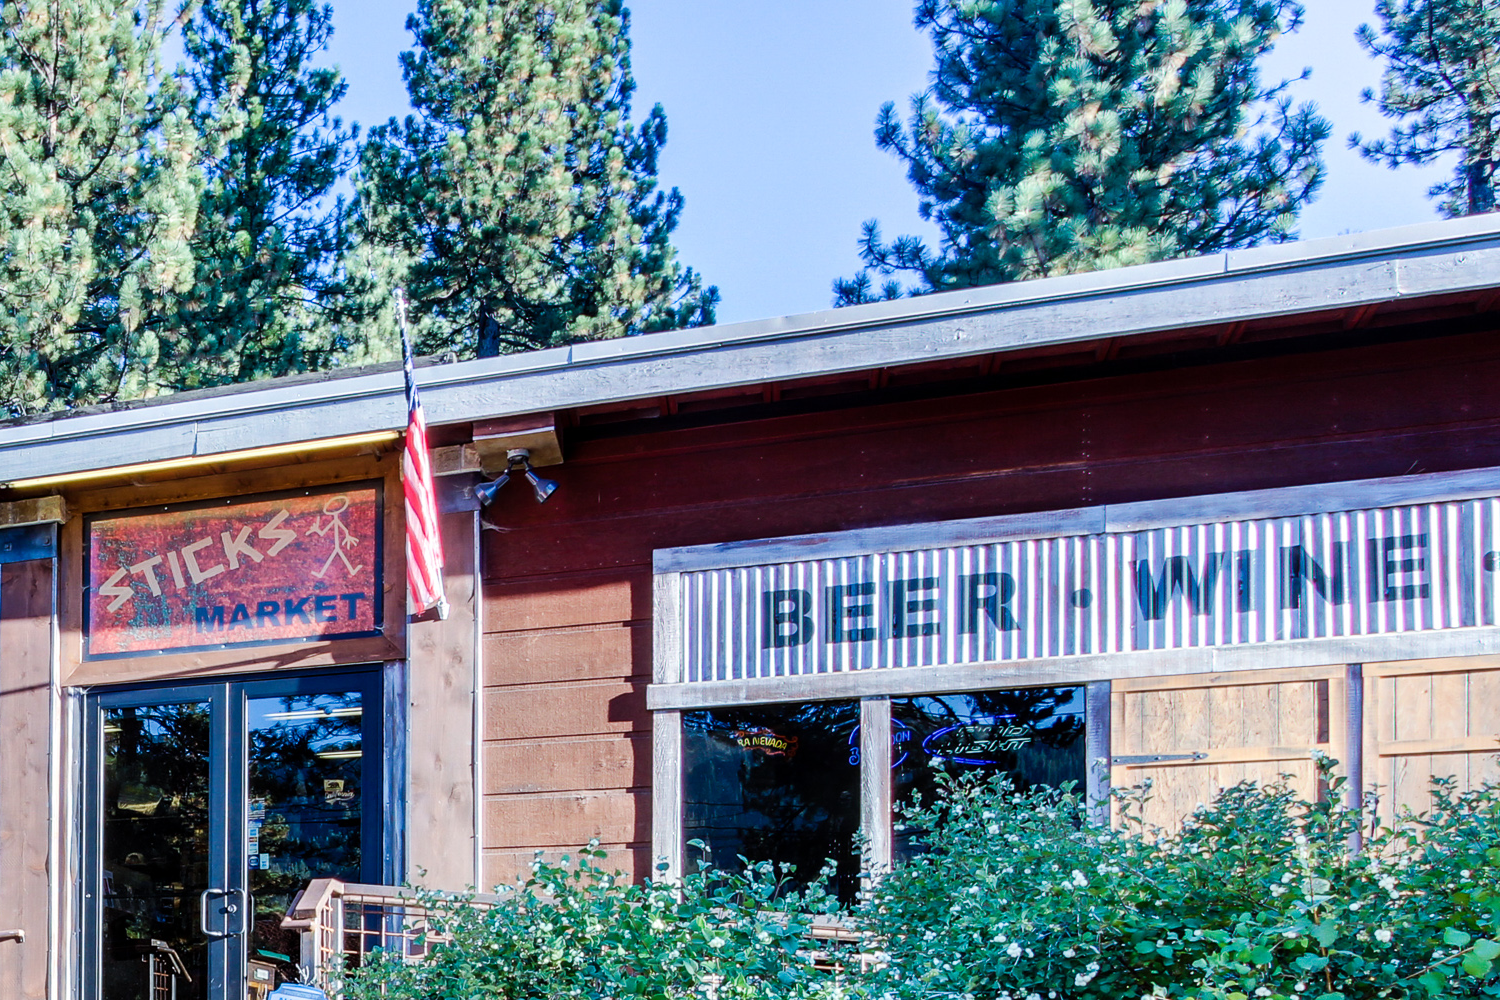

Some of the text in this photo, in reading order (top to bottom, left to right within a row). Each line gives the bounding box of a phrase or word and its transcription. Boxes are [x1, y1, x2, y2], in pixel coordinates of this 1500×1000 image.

[99, 509, 297, 613] STICKS
[762, 532, 1431, 650] BEER WINE
[195, 592, 365, 633] MARKET
[752, 736, 788, 751] NEVADA
